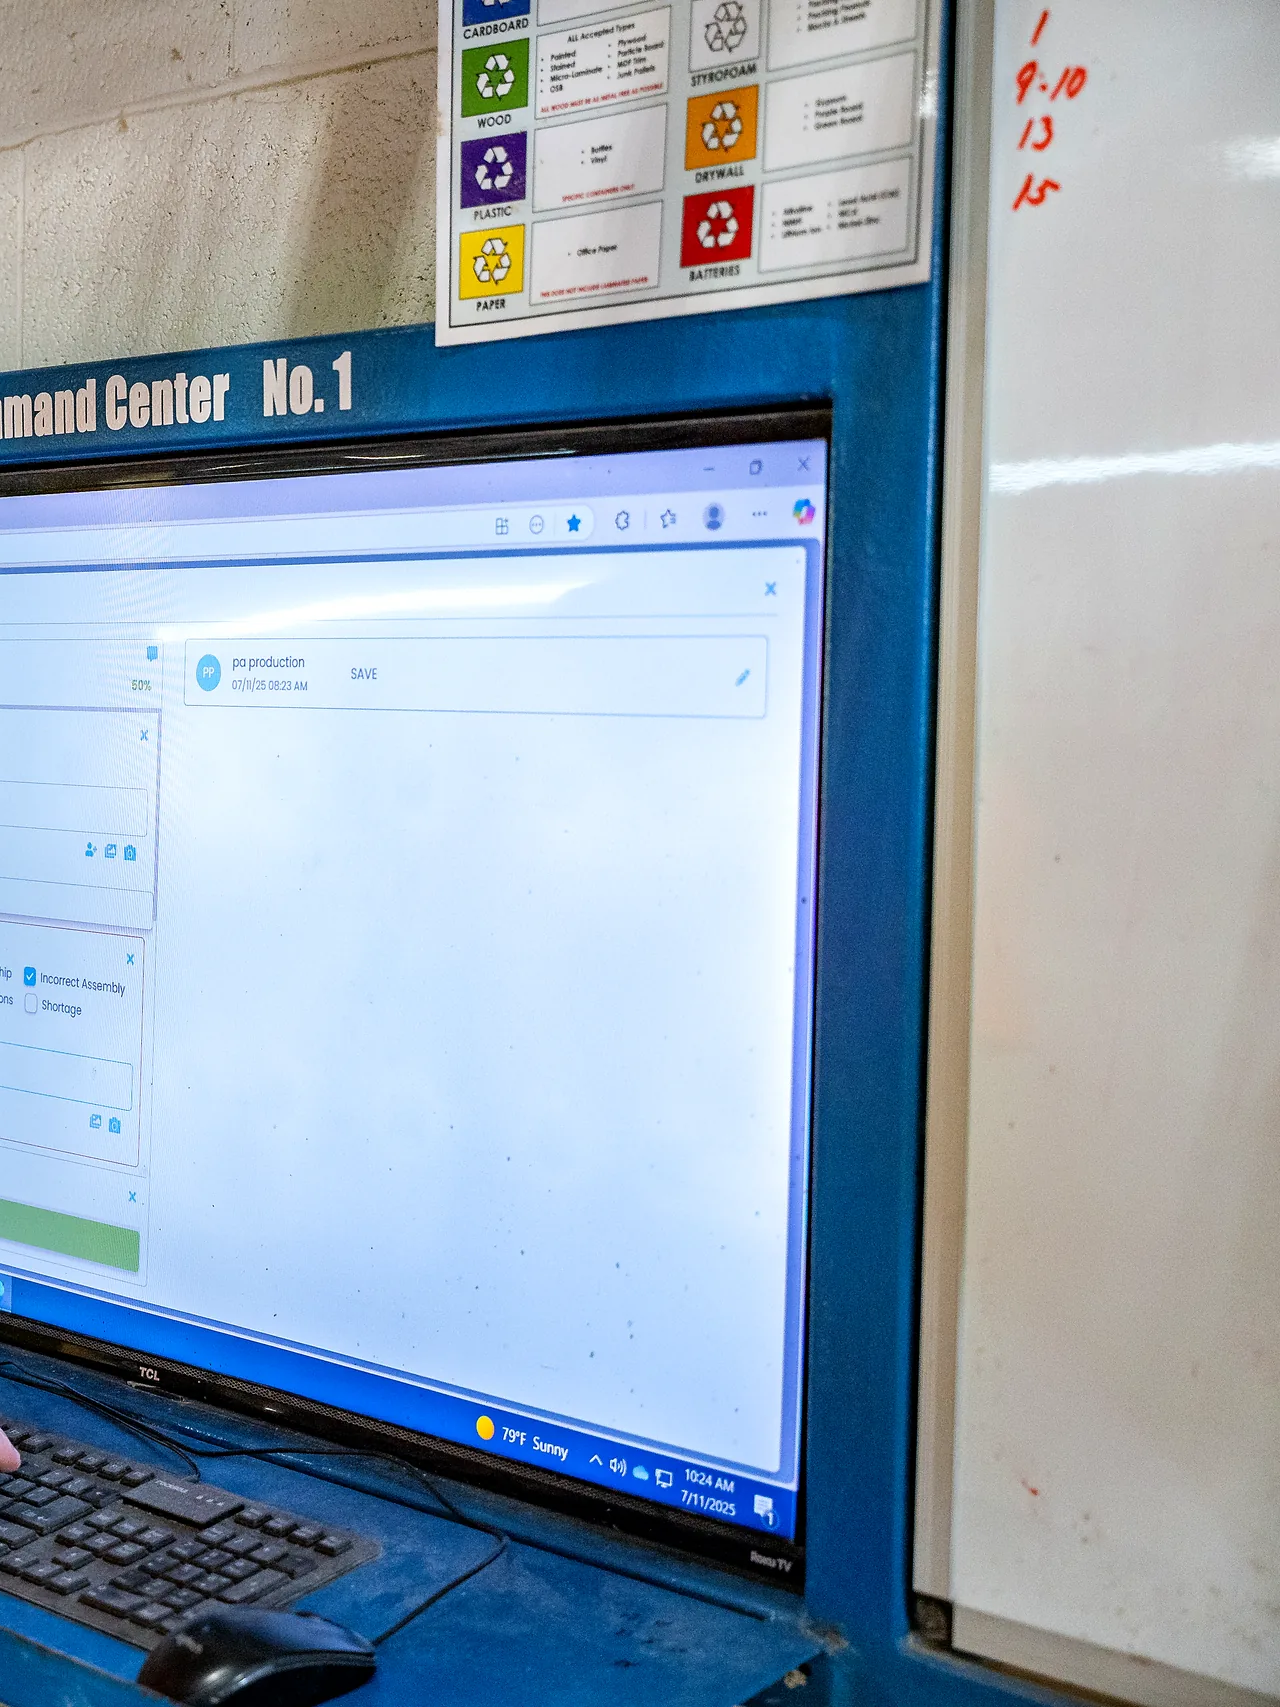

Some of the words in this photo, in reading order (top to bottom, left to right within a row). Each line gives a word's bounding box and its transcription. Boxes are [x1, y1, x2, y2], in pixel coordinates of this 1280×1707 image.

[464, 18, 528, 39] CARDBOARD
[581, 27, 614, 40] Accepted
[616, 23, 634, 32] Types
[1031, 9, 1049, 47] 1
[618, 34, 646, 46] Plywood
[645, 41, 664, 52] Board
[551, 50, 576, 60] Painted
[550, 62, 576, 72] Stained
[550, 67, 602, 82] Micro-Laminate
[691, 63, 757, 87] STYROFOAM
[550, 85, 563, 93] OSB
[478, 114, 512, 128] WOOD
[591, 156, 607, 165] Vinyl
[695, 165, 744, 183] DRYWALL
[1013, 173, 1061, 211] 15
[474, 206, 512, 220] PLASTIC
[577, 246, 596, 256] Office
[598, 244, 617, 254] Paper
[689, 265, 740, 282] BATTERIES
[476, 299, 505, 312] PAPER
[105, 373, 230, 430] Center
[262, 358, 324, 417] No.
[332, 351, 352, 410] 1
[232, 658, 246, 671] pa
[249, 656, 305, 671] production
[202, 667, 214, 678] PP
[351, 668, 377, 680] SAVE
[132, 680, 152, 691] 50%
[232, 678, 266, 692] 07/11/25
[269, 680, 292, 691] 08:23
[294, 681, 308, 691] AM
[40, 973, 79, 988] Incorrect
[82, 978, 125, 997] Assembly
[42, 1000, 82, 1017] Shortage
[140, 1366, 160, 1381] TCL
[502, 1427, 526, 1447] 79°F
[533, 1437, 568, 1462] Sunny
[685, 1468, 712, 1488] 10:24
[714, 1477, 735, 1493] AM
[681, 1489, 736, 1516] 7/11/2025
[777, 1558, 793, 1572] TV
